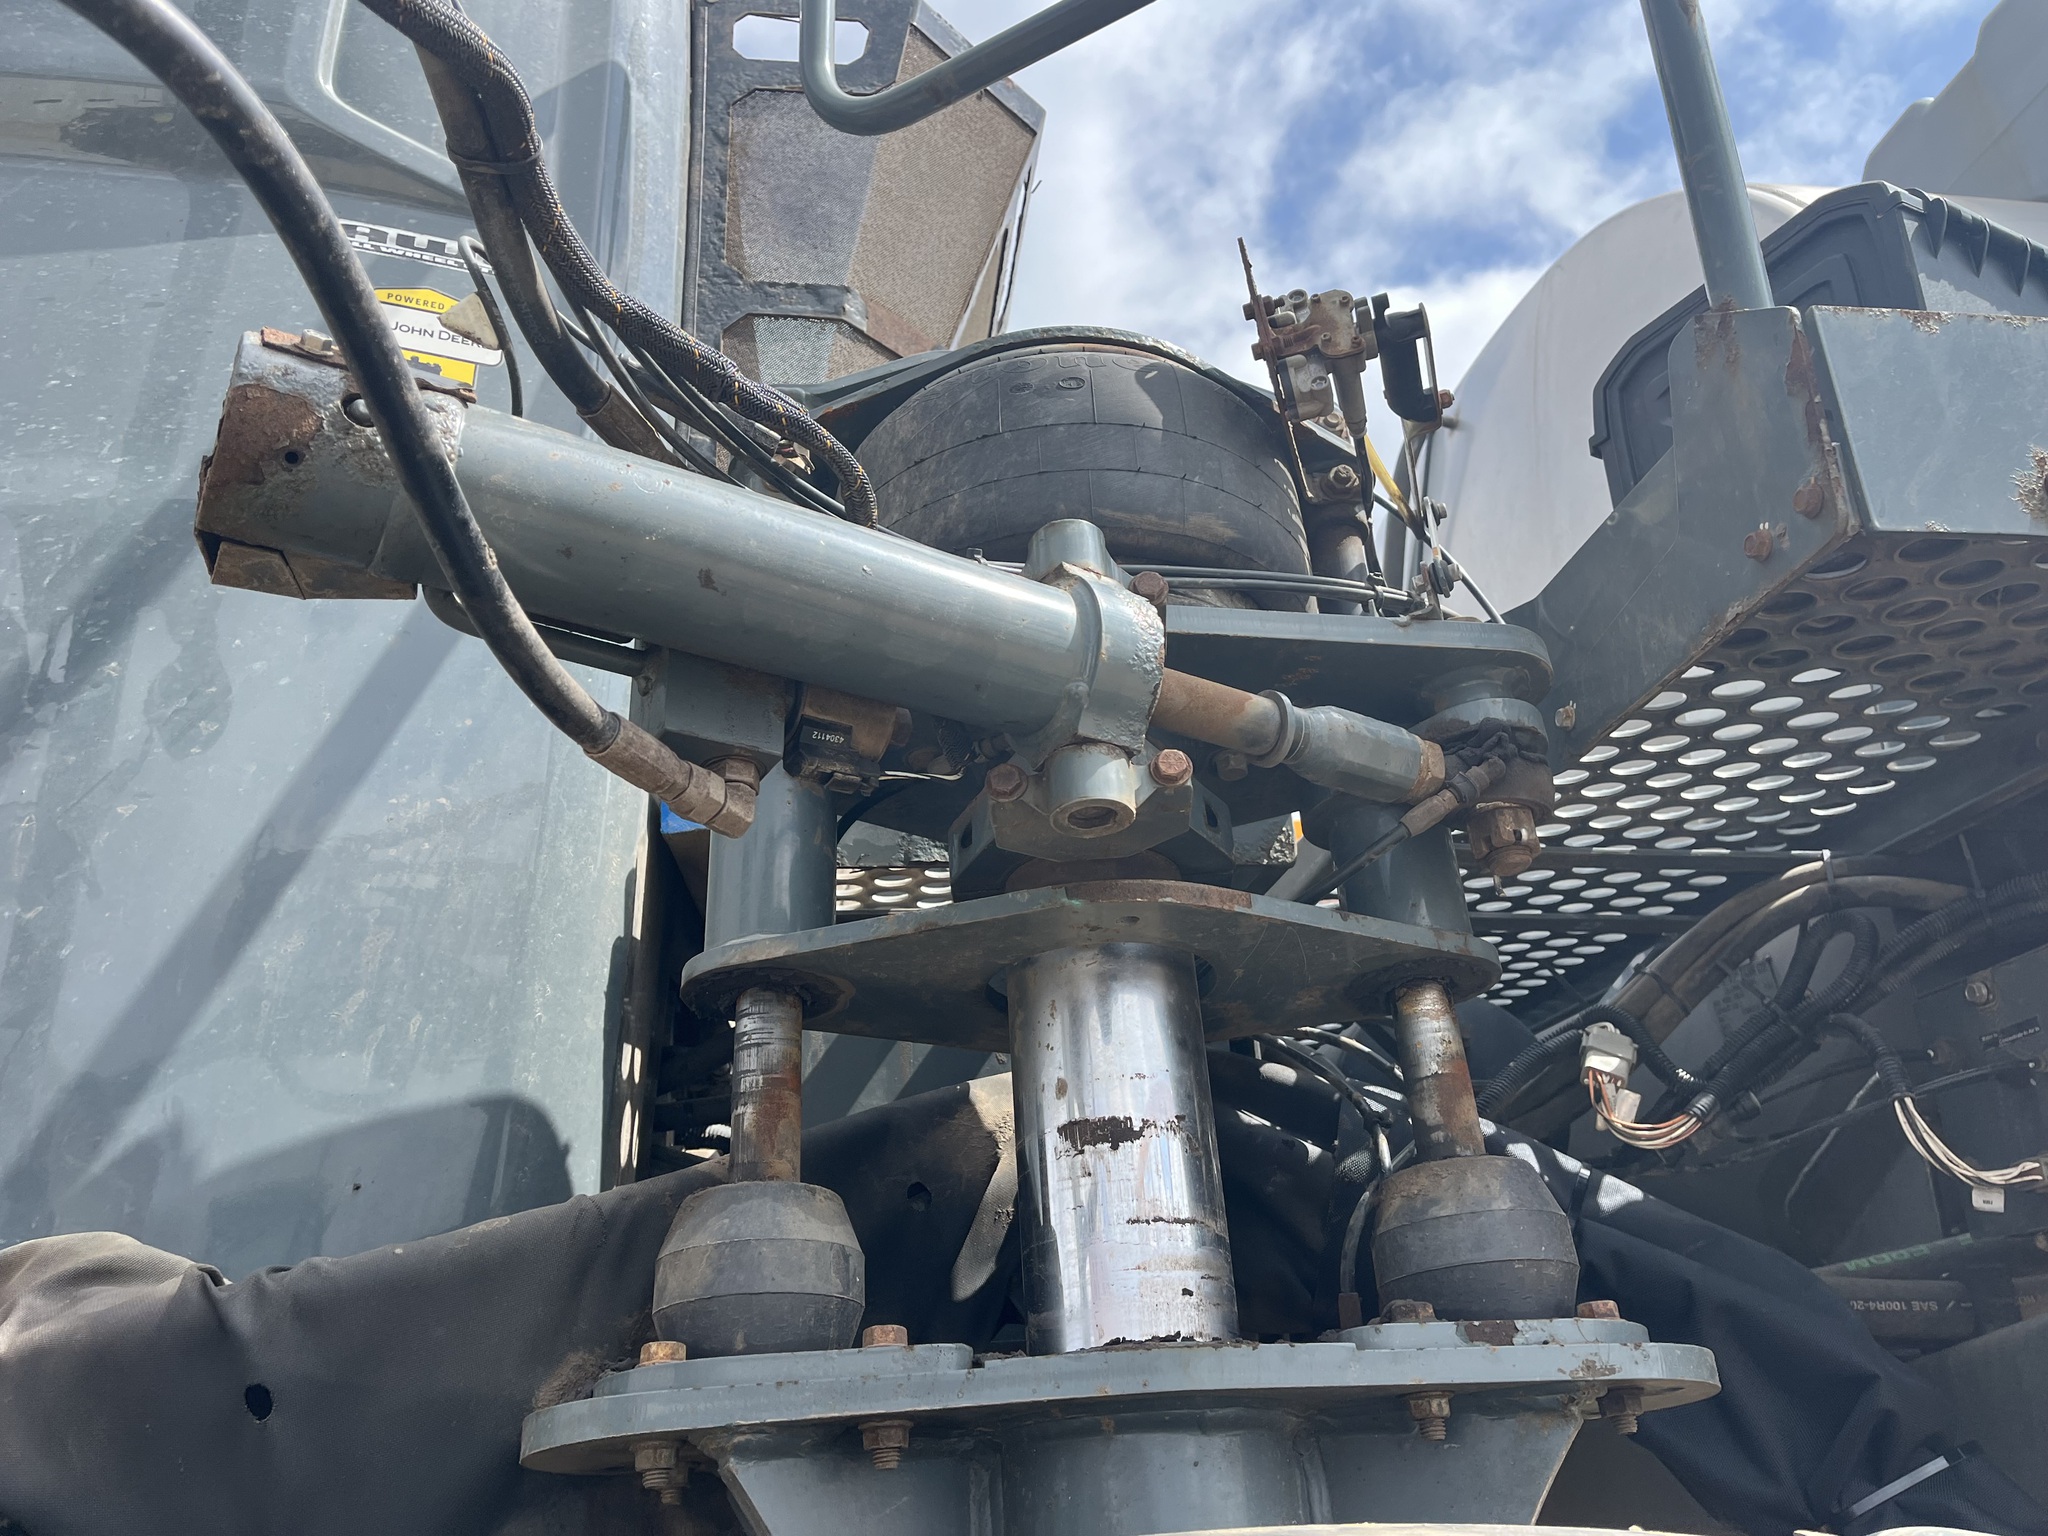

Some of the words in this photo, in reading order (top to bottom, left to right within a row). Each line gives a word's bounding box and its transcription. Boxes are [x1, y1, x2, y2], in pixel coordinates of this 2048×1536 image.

[379, 246, 459, 268] WHEEL
[386, 292, 446, 310] POWERED
[390, 321, 435, 339] JOHN
[438, 330, 483, 349] DEE
[812, 731, 844, 744] 4304112
[1910, 1300, 1938, 1311] SAE
